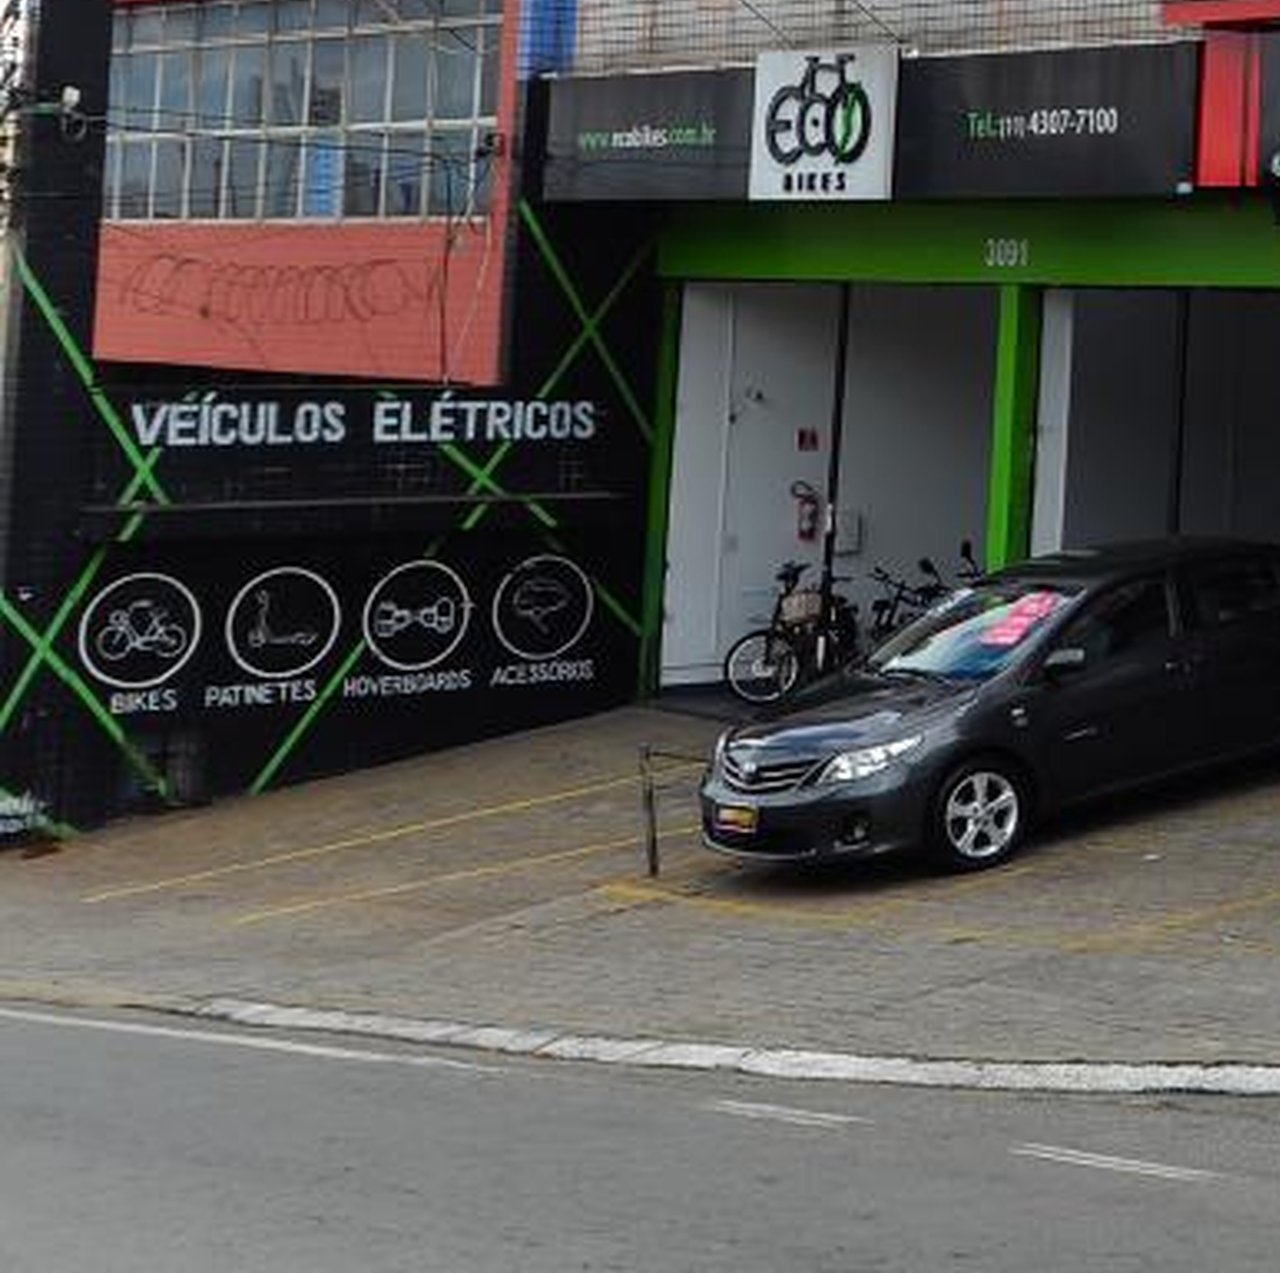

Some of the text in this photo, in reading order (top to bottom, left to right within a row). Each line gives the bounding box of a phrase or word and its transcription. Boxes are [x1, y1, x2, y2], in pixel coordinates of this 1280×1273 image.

[1029, 107, 1119, 135] 4307-7100
[782, 172, 847, 193] BIKES
[131, 390, 596, 446] VEÍCULOS ELÉTRICOS
[203, 679, 317, 708] PATINETES
[342, 669, 472, 697] HOVERBOARDS
[110, 688, 178, 715] BIKES
